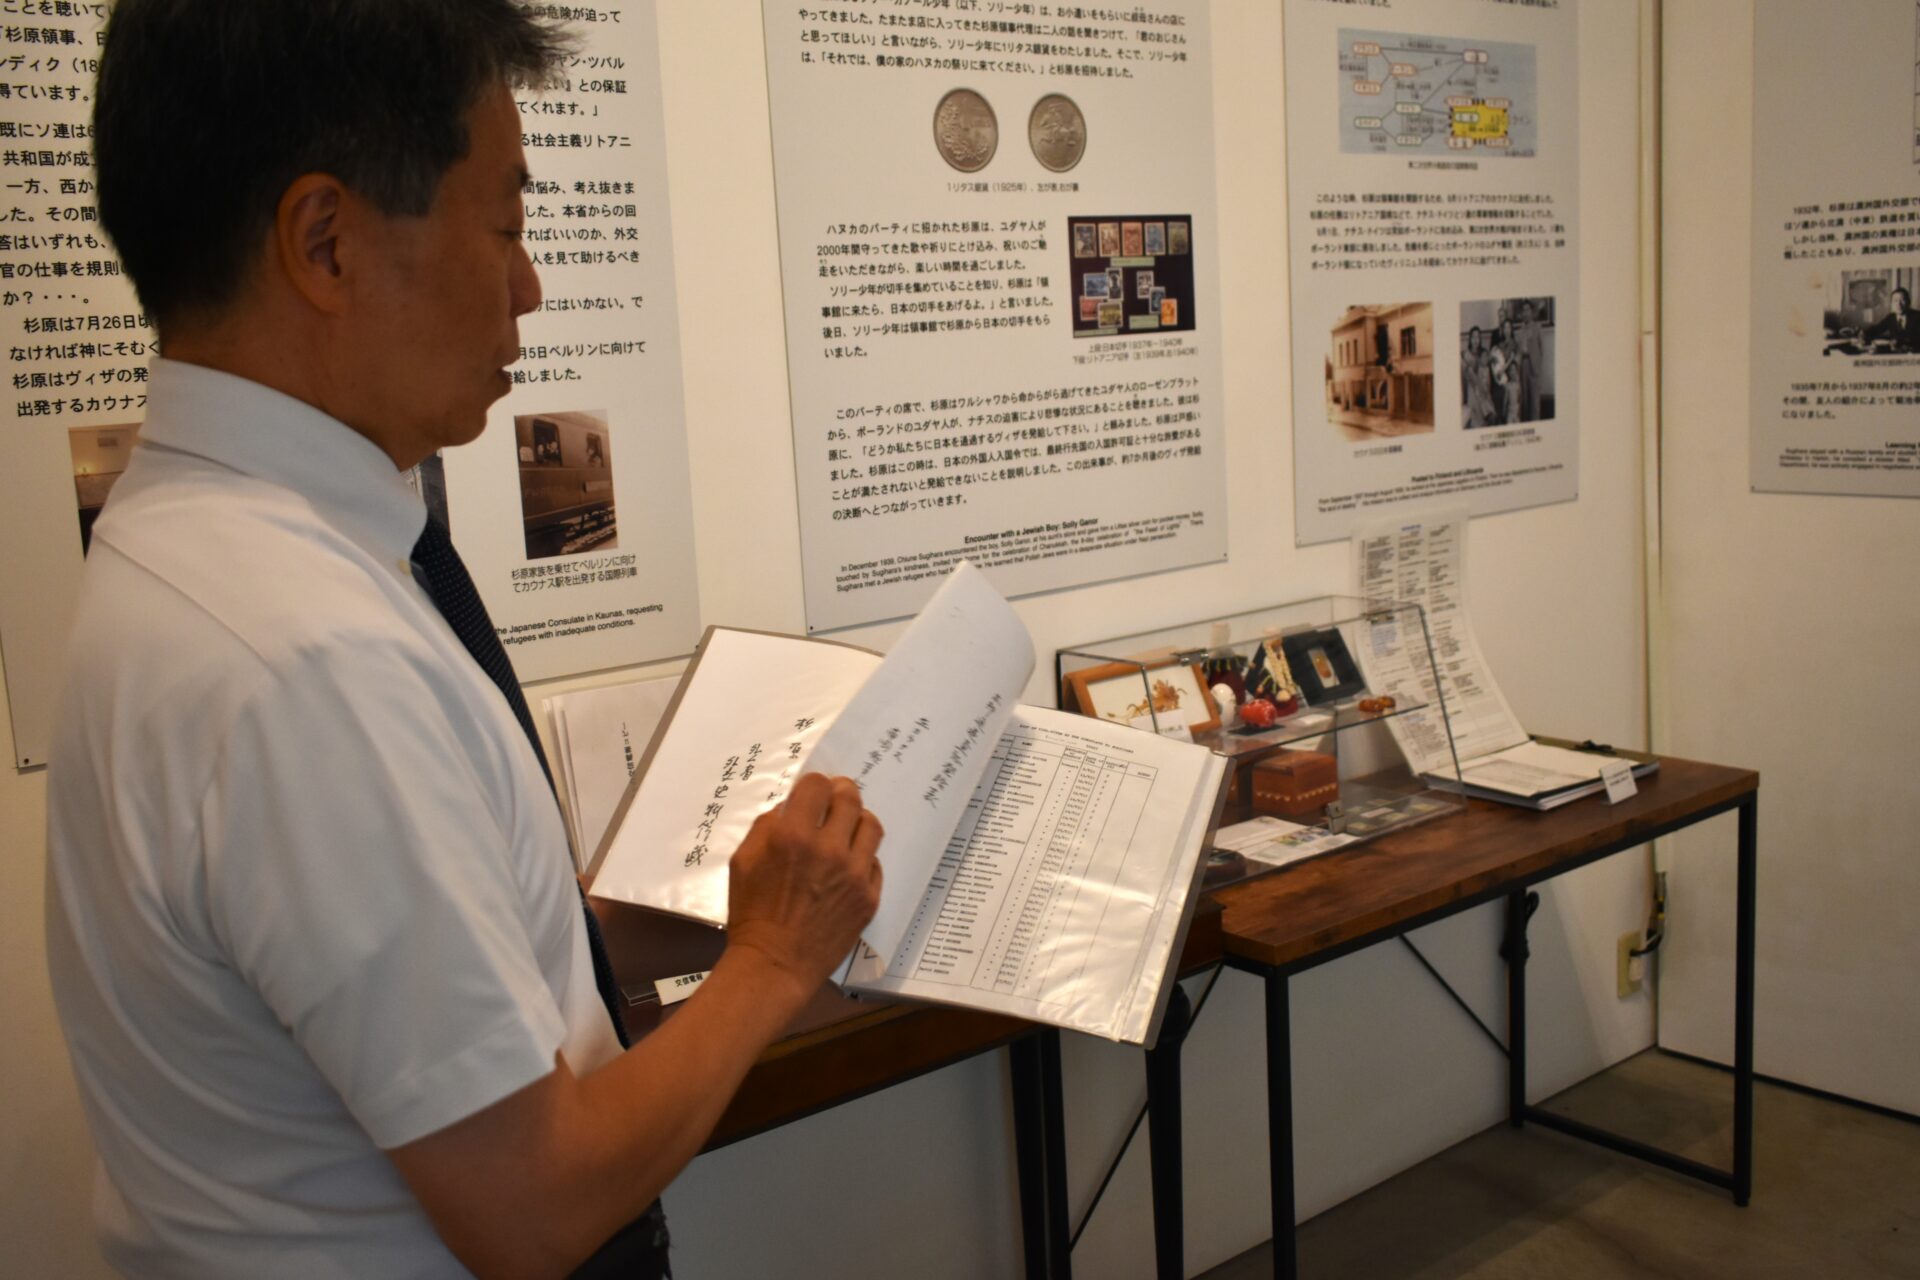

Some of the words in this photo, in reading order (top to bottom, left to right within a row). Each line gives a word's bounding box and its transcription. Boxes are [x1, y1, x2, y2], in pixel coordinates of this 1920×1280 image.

[3, 150, 96, 167] 共和国が成
[525, 204, 637, 218] した。本省からの回
[521, 227, 639, 242] ればいいのか、外交
[532, 250, 640, 265] 人を見て助けるべき
[0, 260, 126, 278] 官の仕事を規則
[10, 340, 159, 361] なければ神にそむく
[824, 345, 868, 359] いました。
[964, 532, 1000, 545] Encounter
[1001, 529, 1015, 539] with
[1022, 526, 1045, 536] Jewish
[1062, 519, 1078, 531] Solly
[1079, 517, 1099, 527] Ganor
[509, 621, 546, 634] Japanese
[548, 615, 585, 628] Consulate
[587, 613, 594, 621] in
[595, 610, 625, 621] Kaunas,
[626, 603, 664, 617] requesting
[503, 633, 537, 646] refugees
[538, 630, 554, 640] with
[555, 624, 596, 637] inadequate
[597, 618, 636, 631] conditions.
